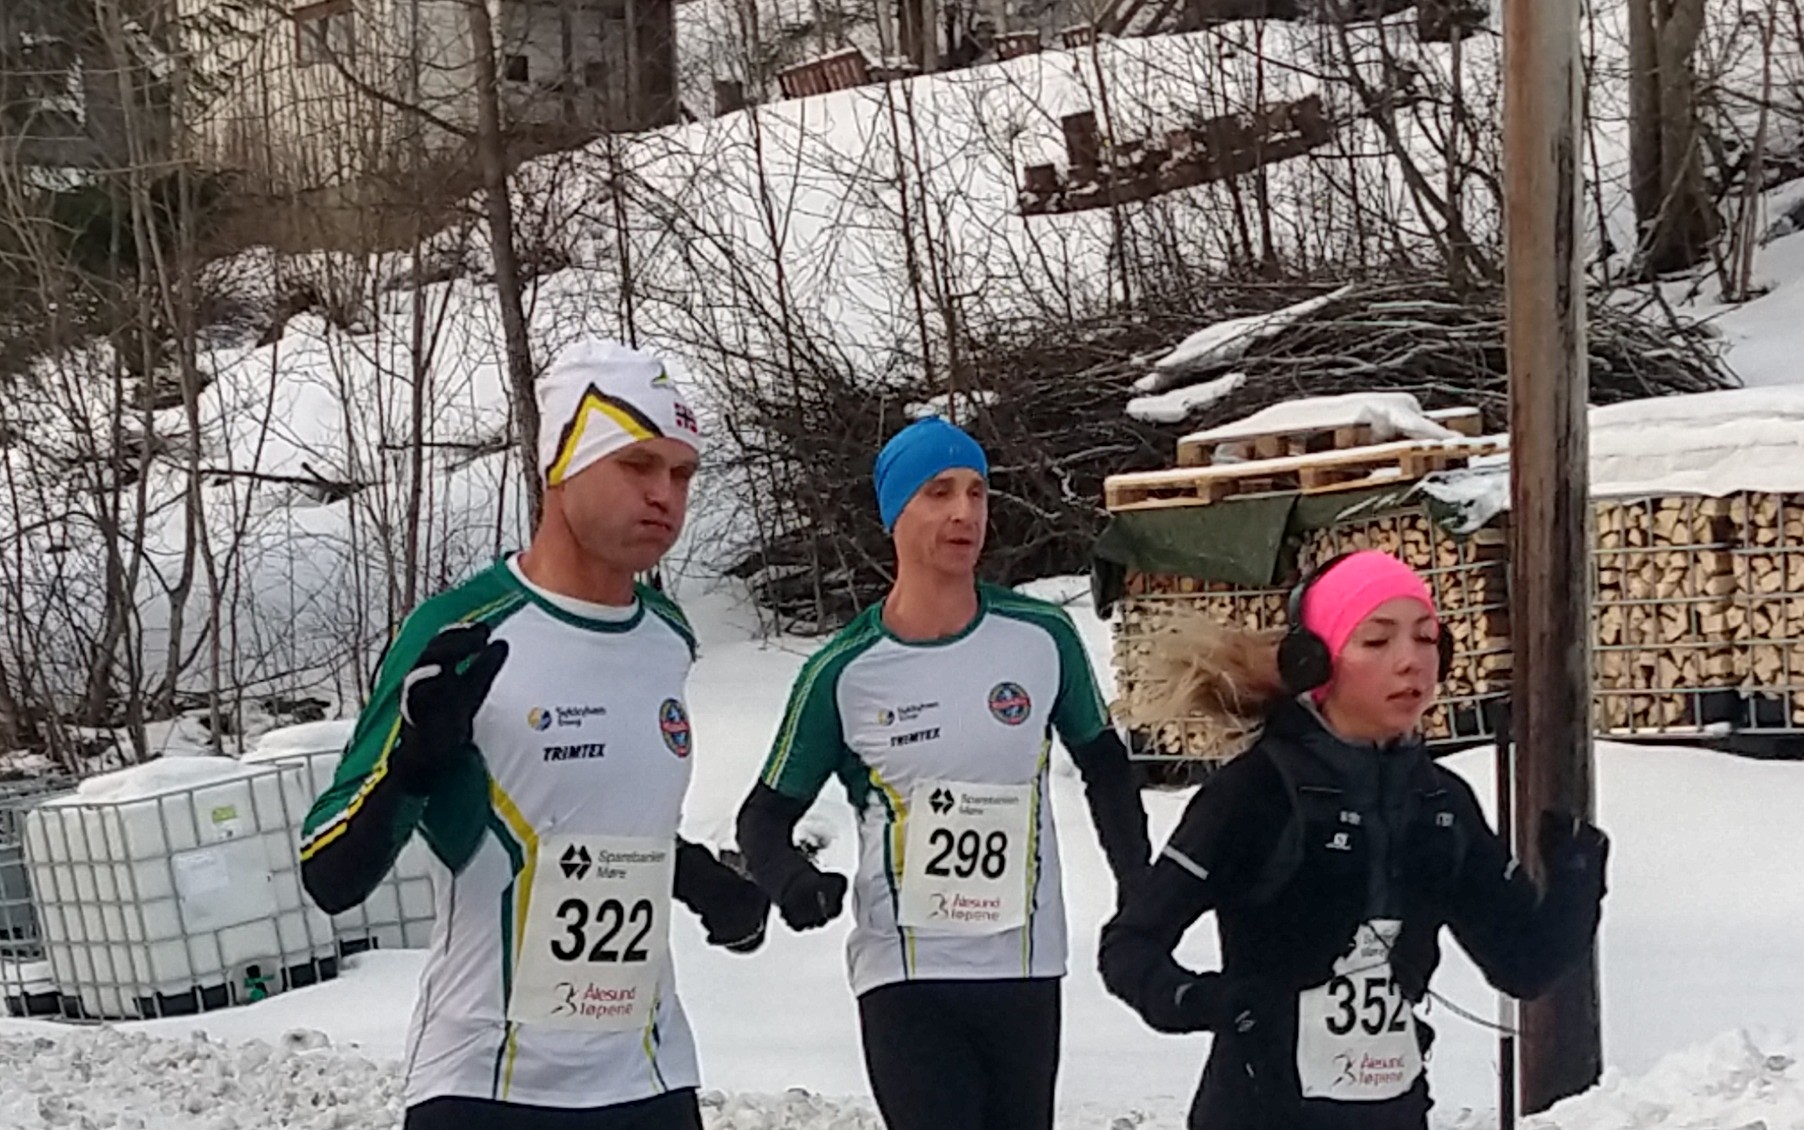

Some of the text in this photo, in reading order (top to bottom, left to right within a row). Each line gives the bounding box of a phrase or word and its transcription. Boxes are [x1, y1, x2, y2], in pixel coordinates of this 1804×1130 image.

[890, 727, 940, 747] TRIMTEX
[543, 744, 606, 762] TRIMTEX
[597, 850, 666, 866] Sparebanken
[925, 828, 1008, 879] 298
[596, 866, 627, 879] Møre
[952, 893, 1000, 908] Ålesund
[951, 908, 999, 922] løpene
[551, 898, 653, 962] 322
[583, 982, 636, 1002] Ålesund
[580, 1001, 634, 1020] løpene
[1326, 977, 1407, 1036] 352
